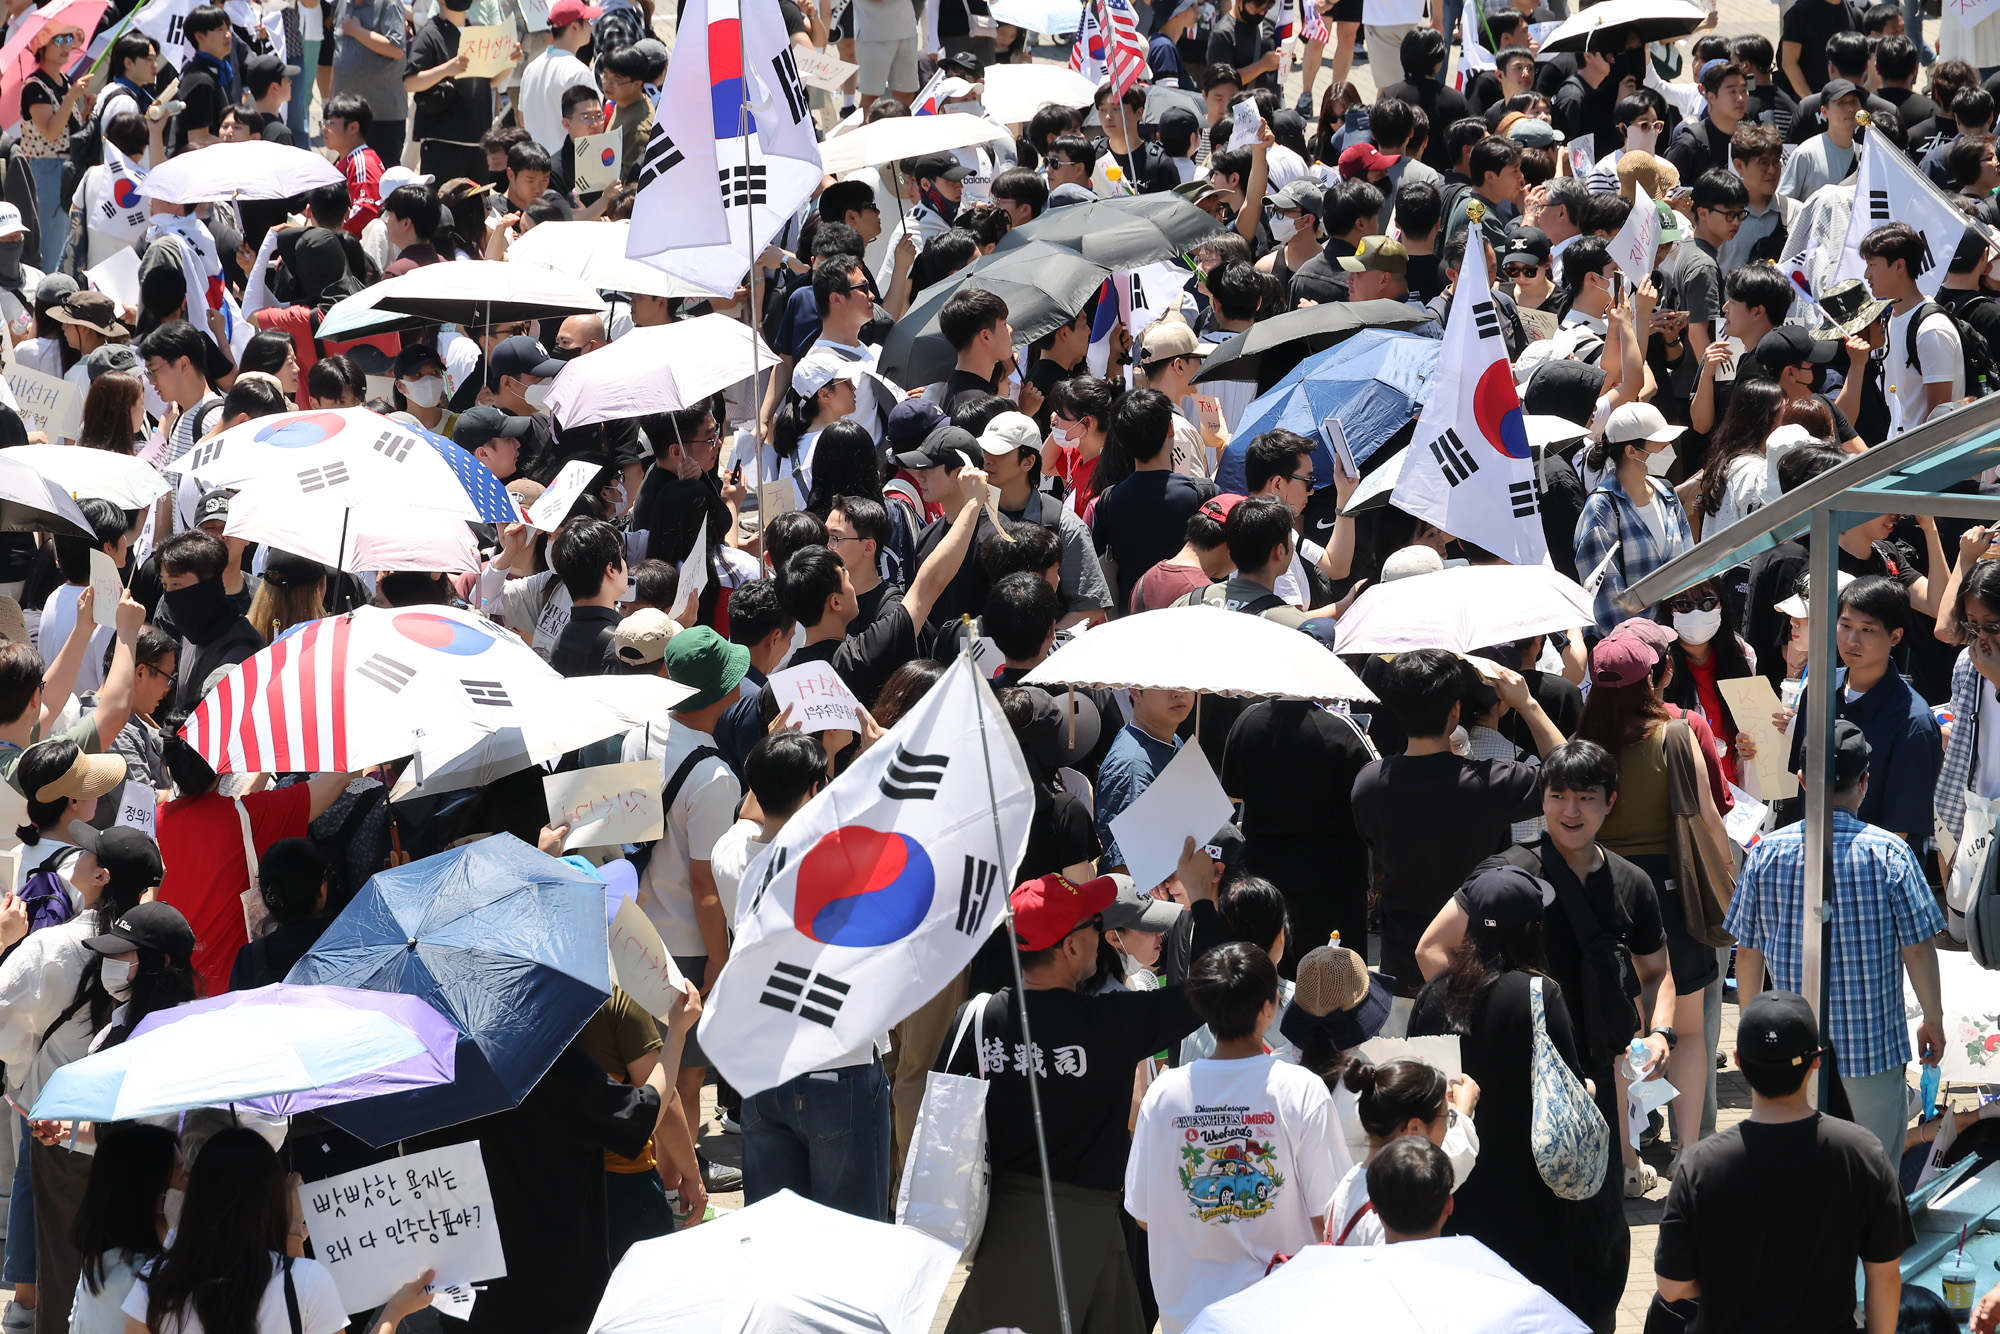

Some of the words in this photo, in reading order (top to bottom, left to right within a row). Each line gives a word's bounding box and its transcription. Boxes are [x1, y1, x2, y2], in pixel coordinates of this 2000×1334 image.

[463, 32, 513, 61] 재선거
[1629, 207, 1657, 266] 재선거
[8, 374, 60, 410] 재선거
[982, 1036, 1088, 1078] 特戰司
[1194, 1104, 1227, 1114] Diamond
[1227, 1106, 1250, 1115] escape
[1200, 1126, 1253, 1143] Weekends
[312, 1174, 402, 1218] 빳빳한
[405, 1166, 458, 1200] 용지는
[325, 1236, 353, 1264] 왜
[358, 1230, 378, 1249] 다
[385, 1205, 481, 1246] 민주당표야?
